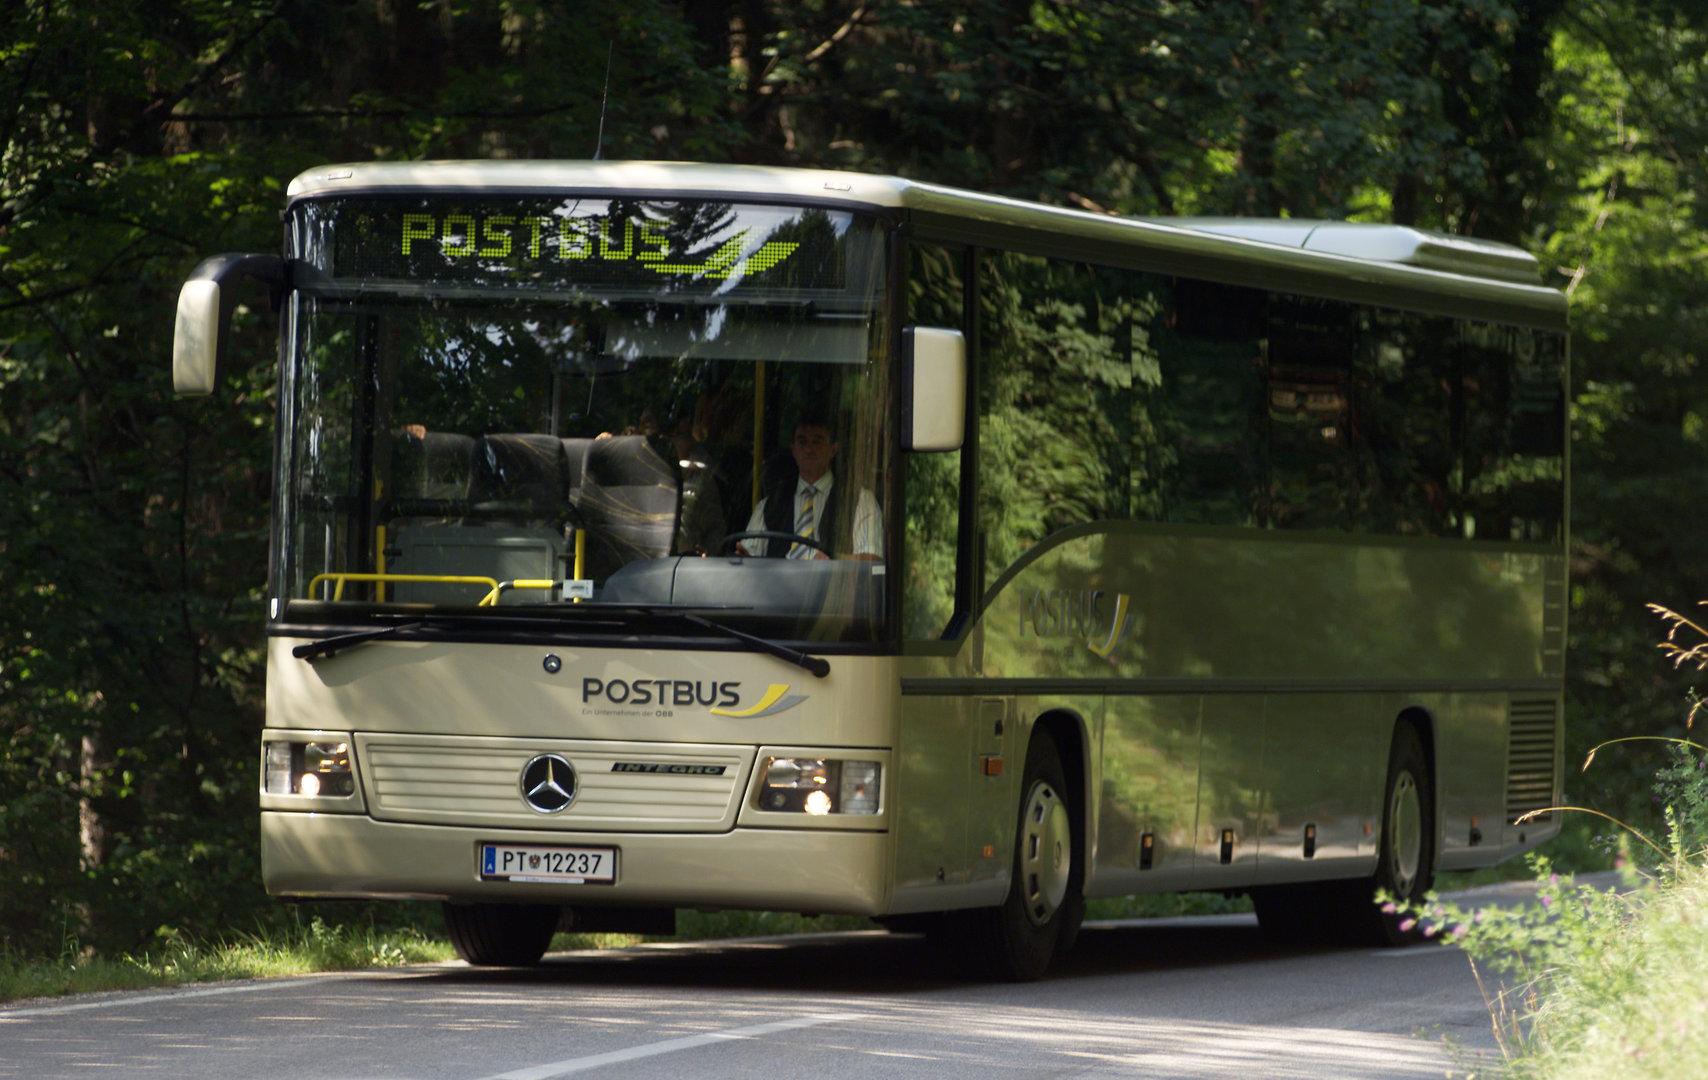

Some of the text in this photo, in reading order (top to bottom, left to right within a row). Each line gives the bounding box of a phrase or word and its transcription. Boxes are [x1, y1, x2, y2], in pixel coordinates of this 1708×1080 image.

[401, 213, 670, 262] POSTBUS
[582, 678, 741, 707] POSTBUS
[503, 851, 602, 874] PT 12237
